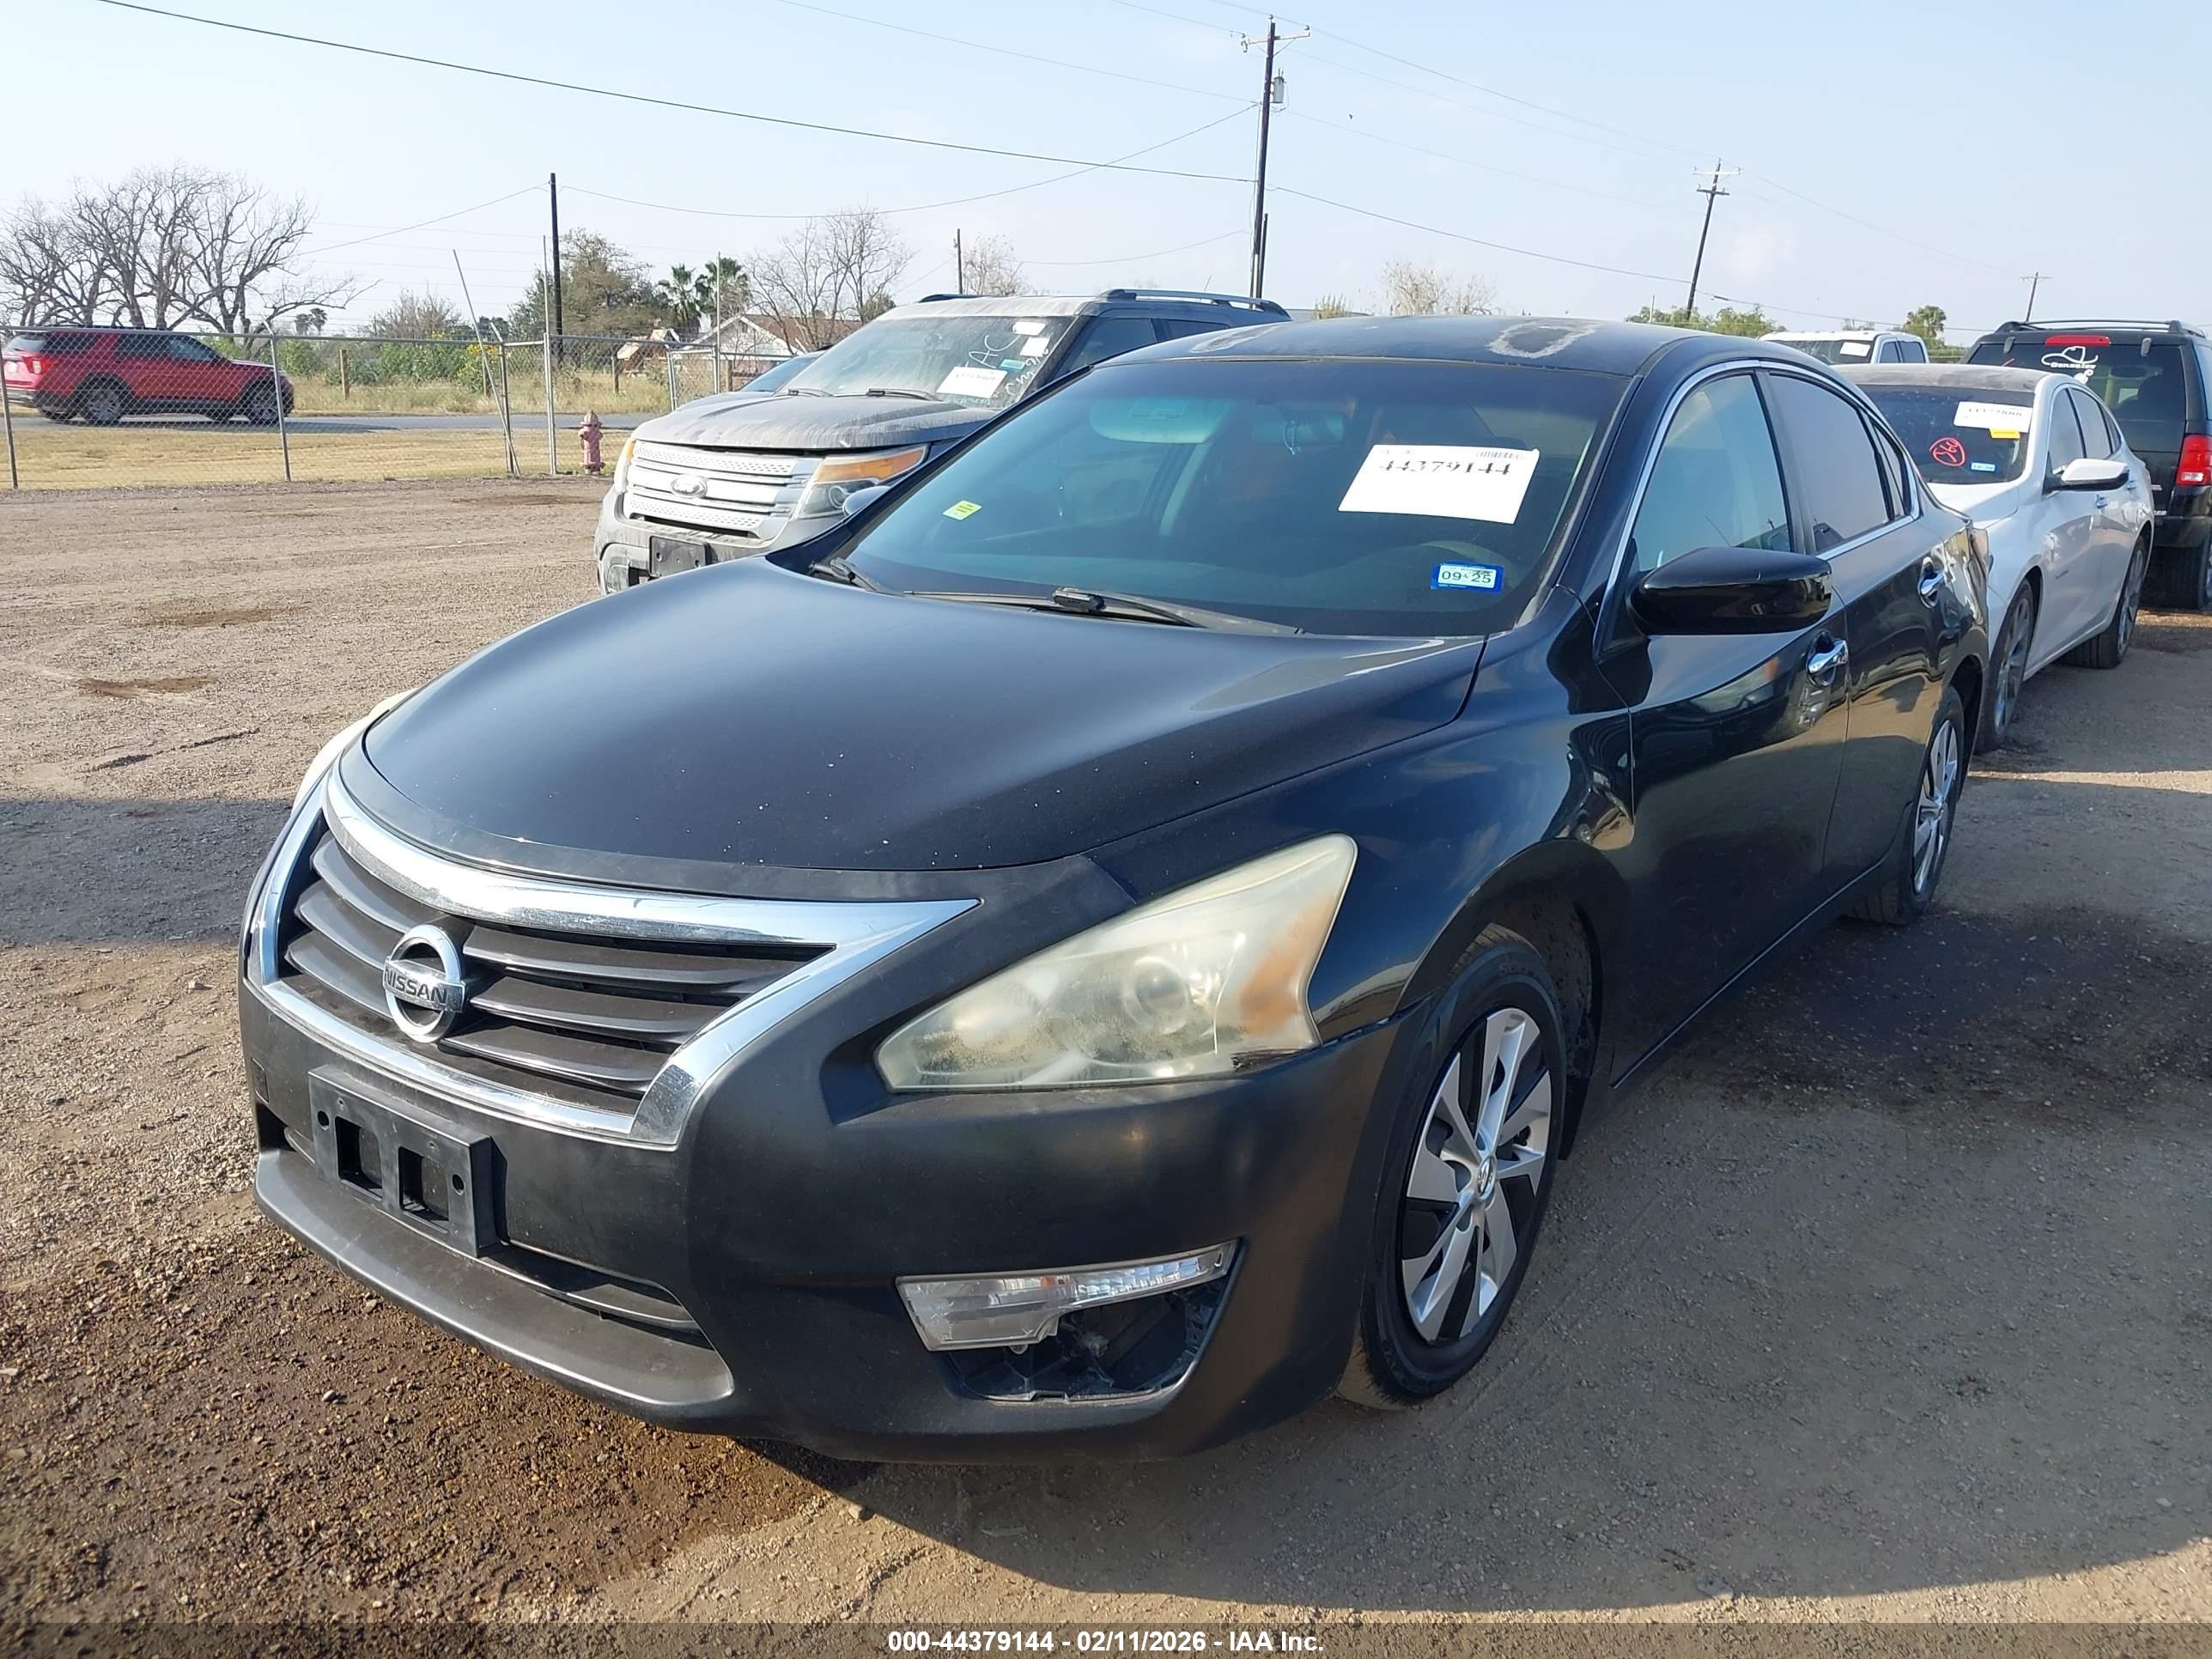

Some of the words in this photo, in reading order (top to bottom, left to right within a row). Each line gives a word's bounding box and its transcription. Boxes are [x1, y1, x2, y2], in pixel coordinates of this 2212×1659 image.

[1441, 571, 1462, 581] 09
[1471, 570, 1492, 584] 25
[386, 969, 447, 1004] NISSAN
